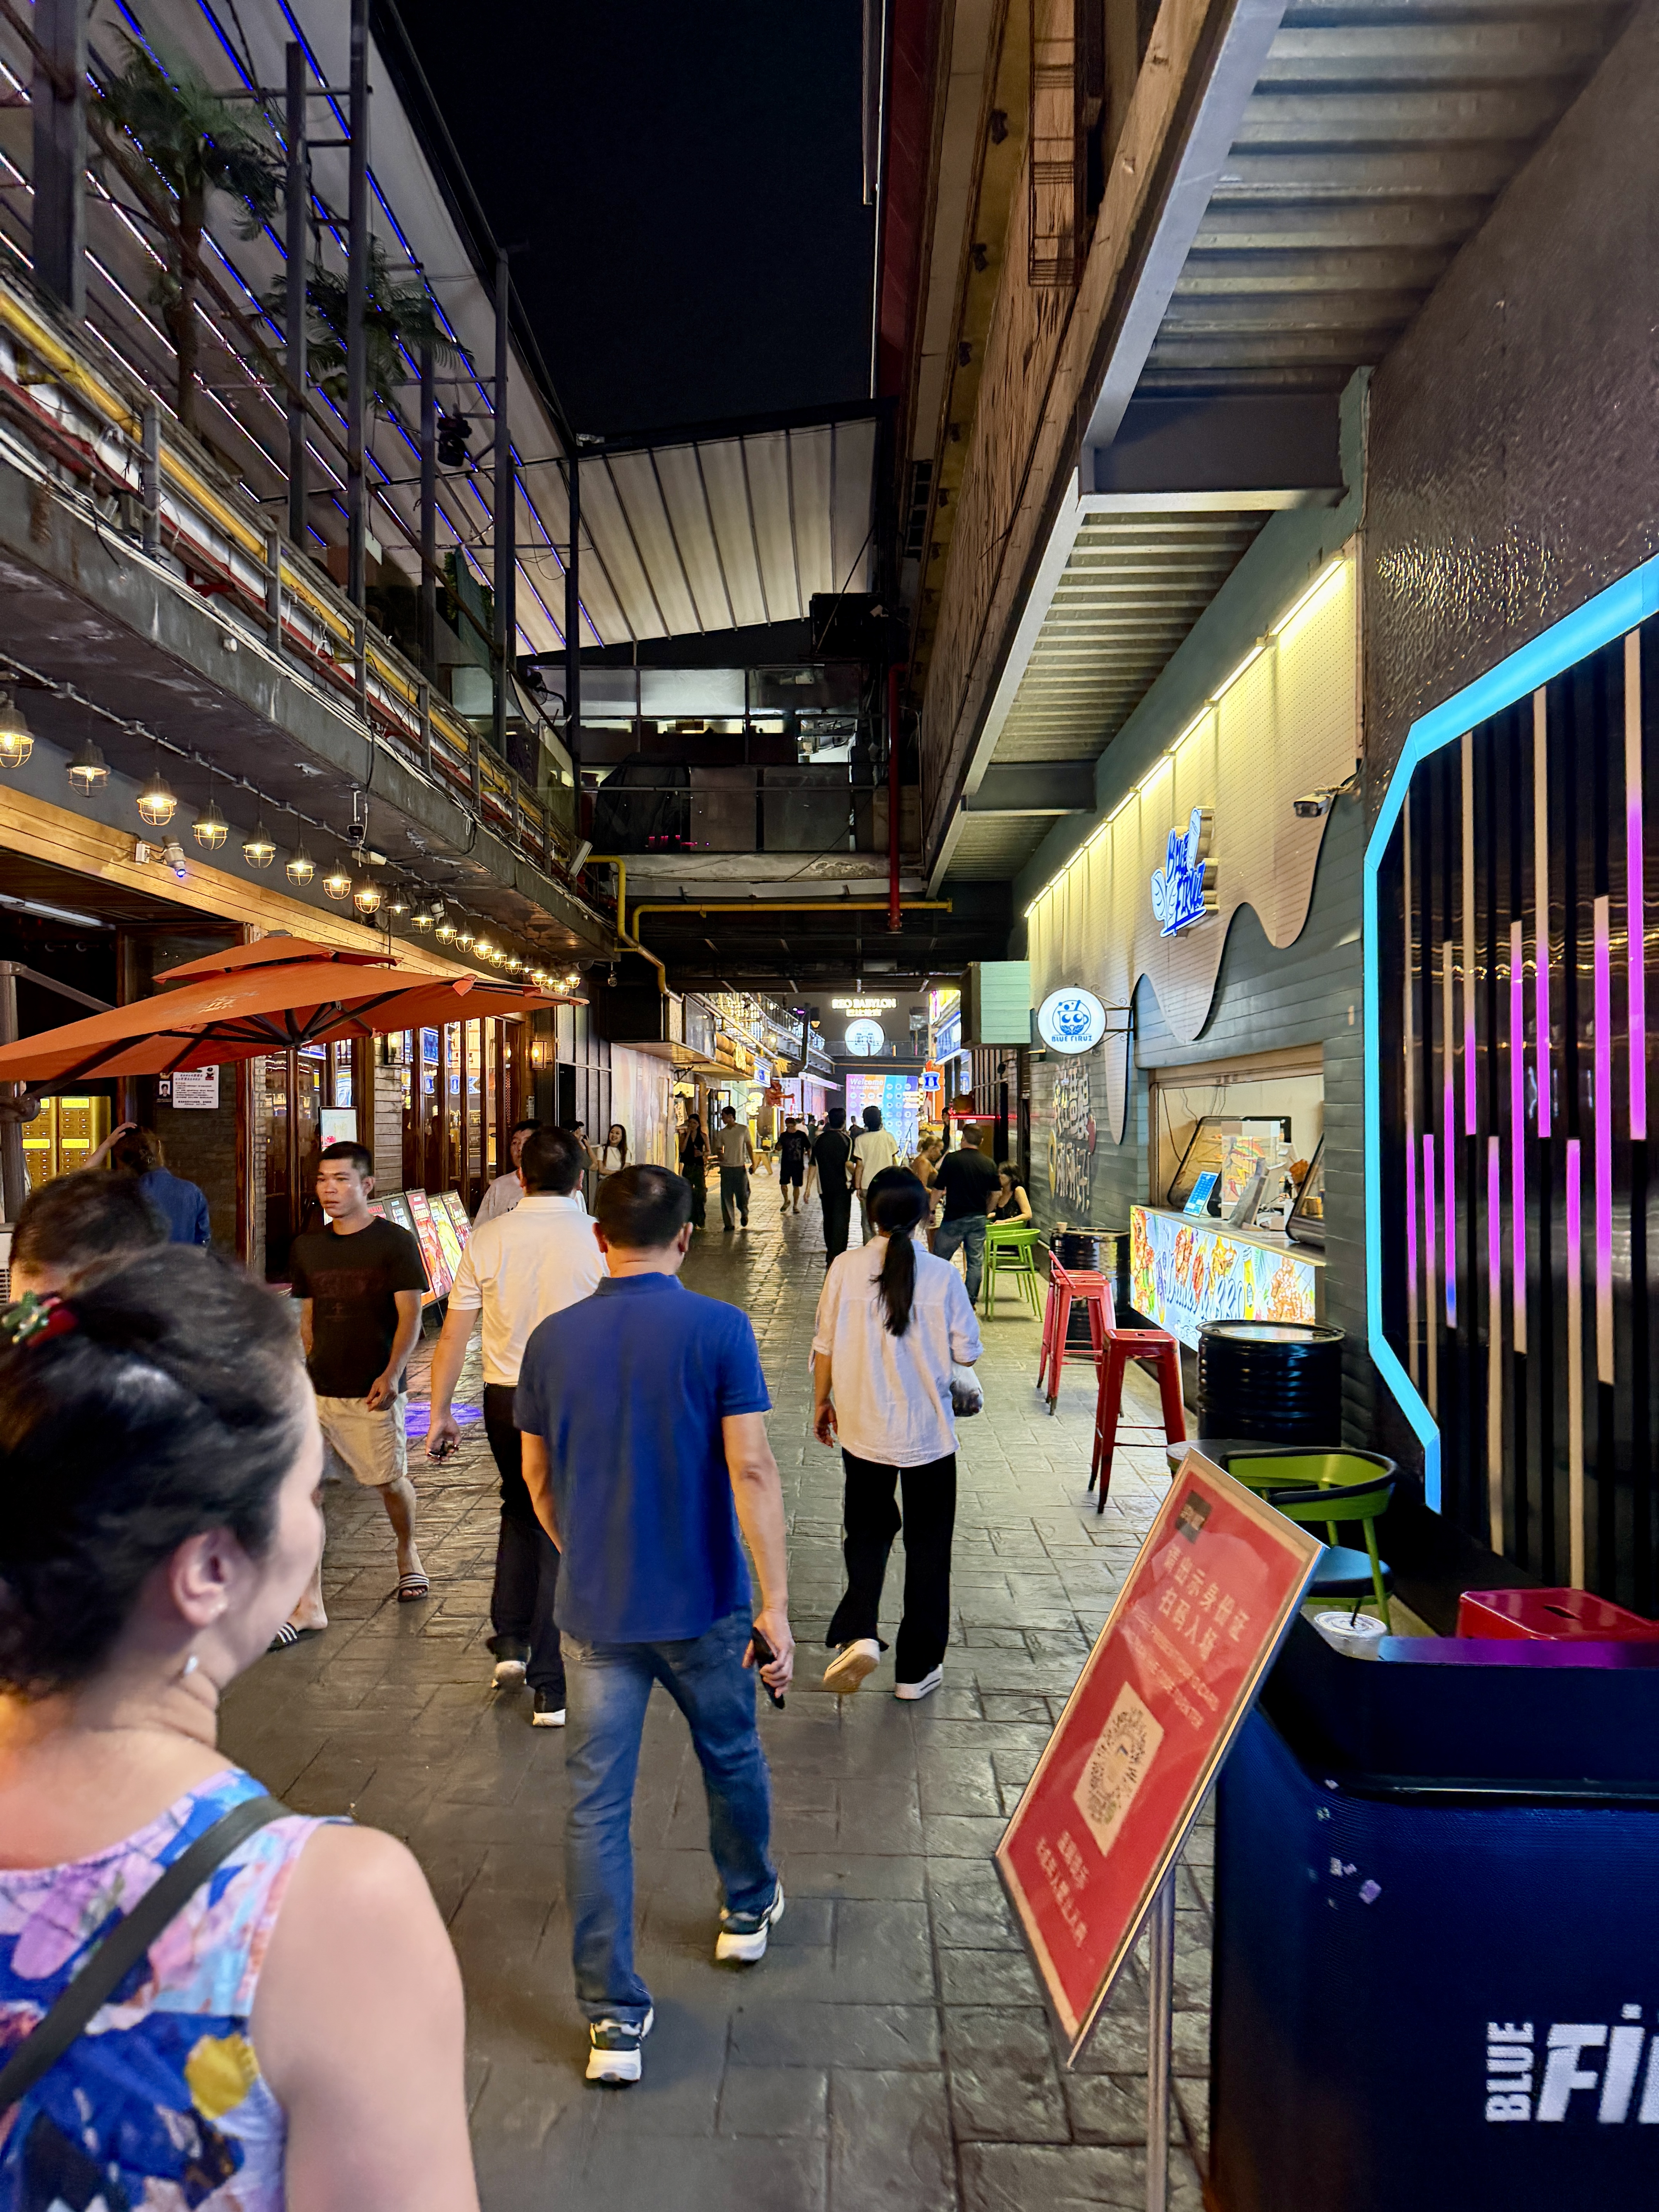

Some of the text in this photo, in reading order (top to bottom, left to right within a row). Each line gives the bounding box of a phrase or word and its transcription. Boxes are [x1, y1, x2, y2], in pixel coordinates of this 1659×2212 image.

[853, 998, 896, 1008] BABYLON
[1159, 1587, 1218, 1661] 扫码入场
[1164, 1545, 1250, 1642] 请出示身份证
[1486, 2022, 1534, 2122] BLUE
